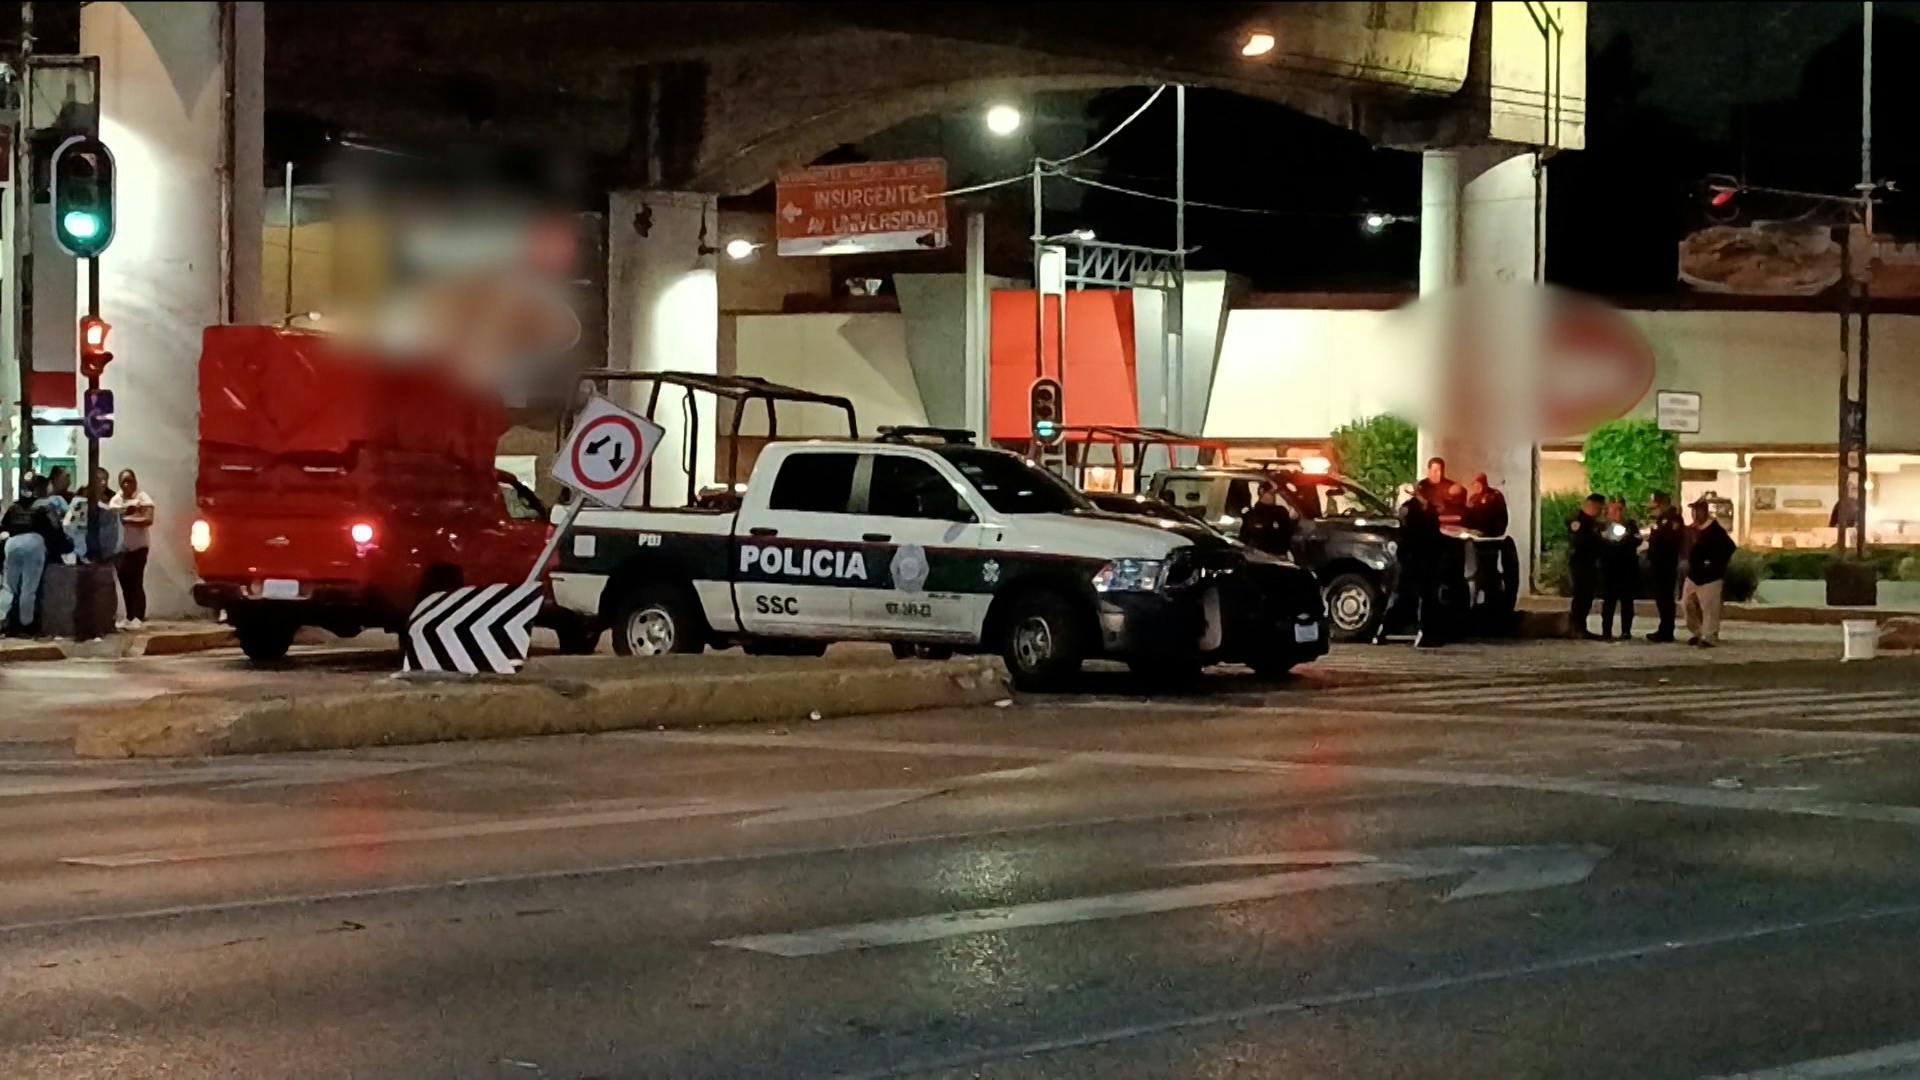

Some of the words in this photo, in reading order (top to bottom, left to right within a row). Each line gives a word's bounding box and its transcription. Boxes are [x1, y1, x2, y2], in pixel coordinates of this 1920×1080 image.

[813, 184, 930, 209] INSURGENTES
[832, 210, 939, 233] UNIVERSIDAD
[739, 545, 868, 580] POLICIA
[756, 595, 799, 615] SSC
